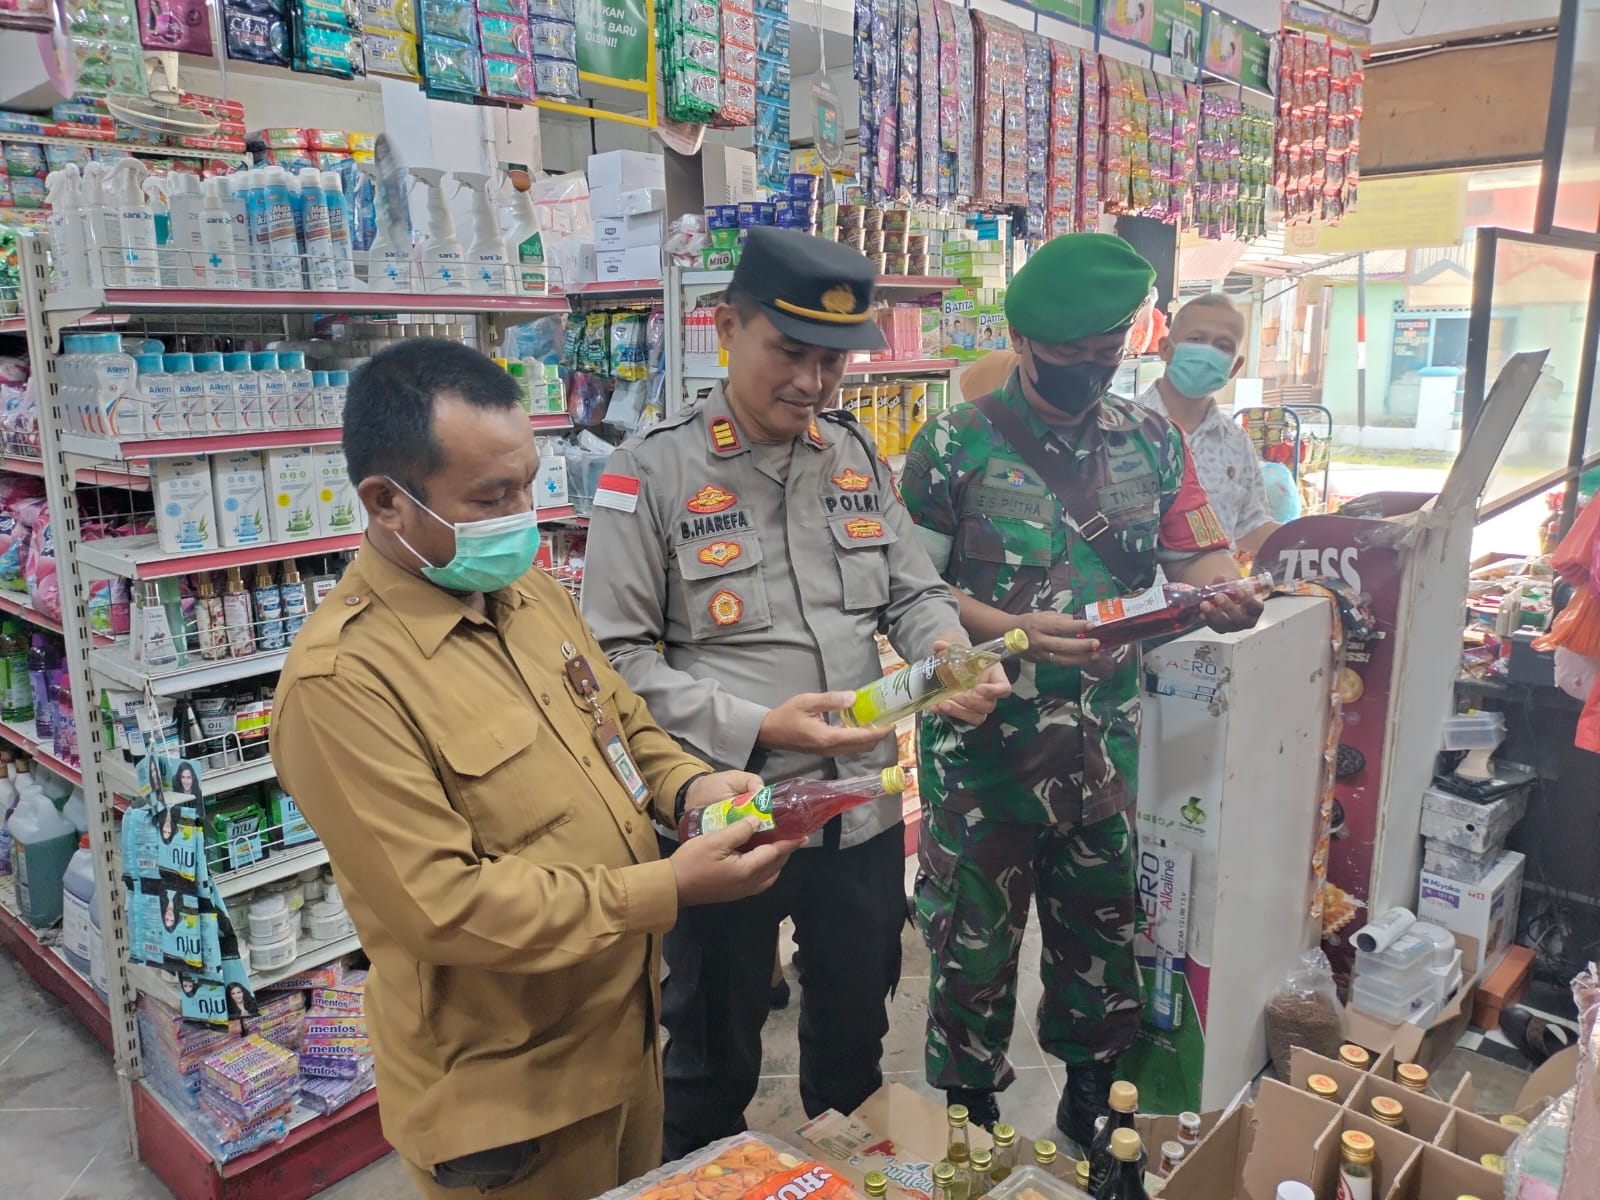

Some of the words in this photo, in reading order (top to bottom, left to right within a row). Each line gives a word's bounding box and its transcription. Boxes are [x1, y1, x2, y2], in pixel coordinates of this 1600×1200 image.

[231, 17, 269, 36] CLEAR
[607, 22, 638, 37] BARU
[584, 31, 618, 48] DISINI!
[708, 256, 730, 267] MILO
[945, 300, 974, 314] BATITA
[149, 386, 172, 394] Aiken
[179, 385, 202, 393] Aiken
[209, 383, 231, 391] Aiken
[825, 495, 880, 513] POLRI
[680, 511, 749, 539] B.HAREFA
[207, 722, 224, 730] OIL
[1159, 859, 1176, 911] Alkaline
[314, 997, 348, 1009] mentos
[310, 1025, 356, 1033] mentos
[308, 1045, 354, 1053] mentos
[299, 1066, 338, 1076] mentos
[764, 1165, 833, 1200] CHU
